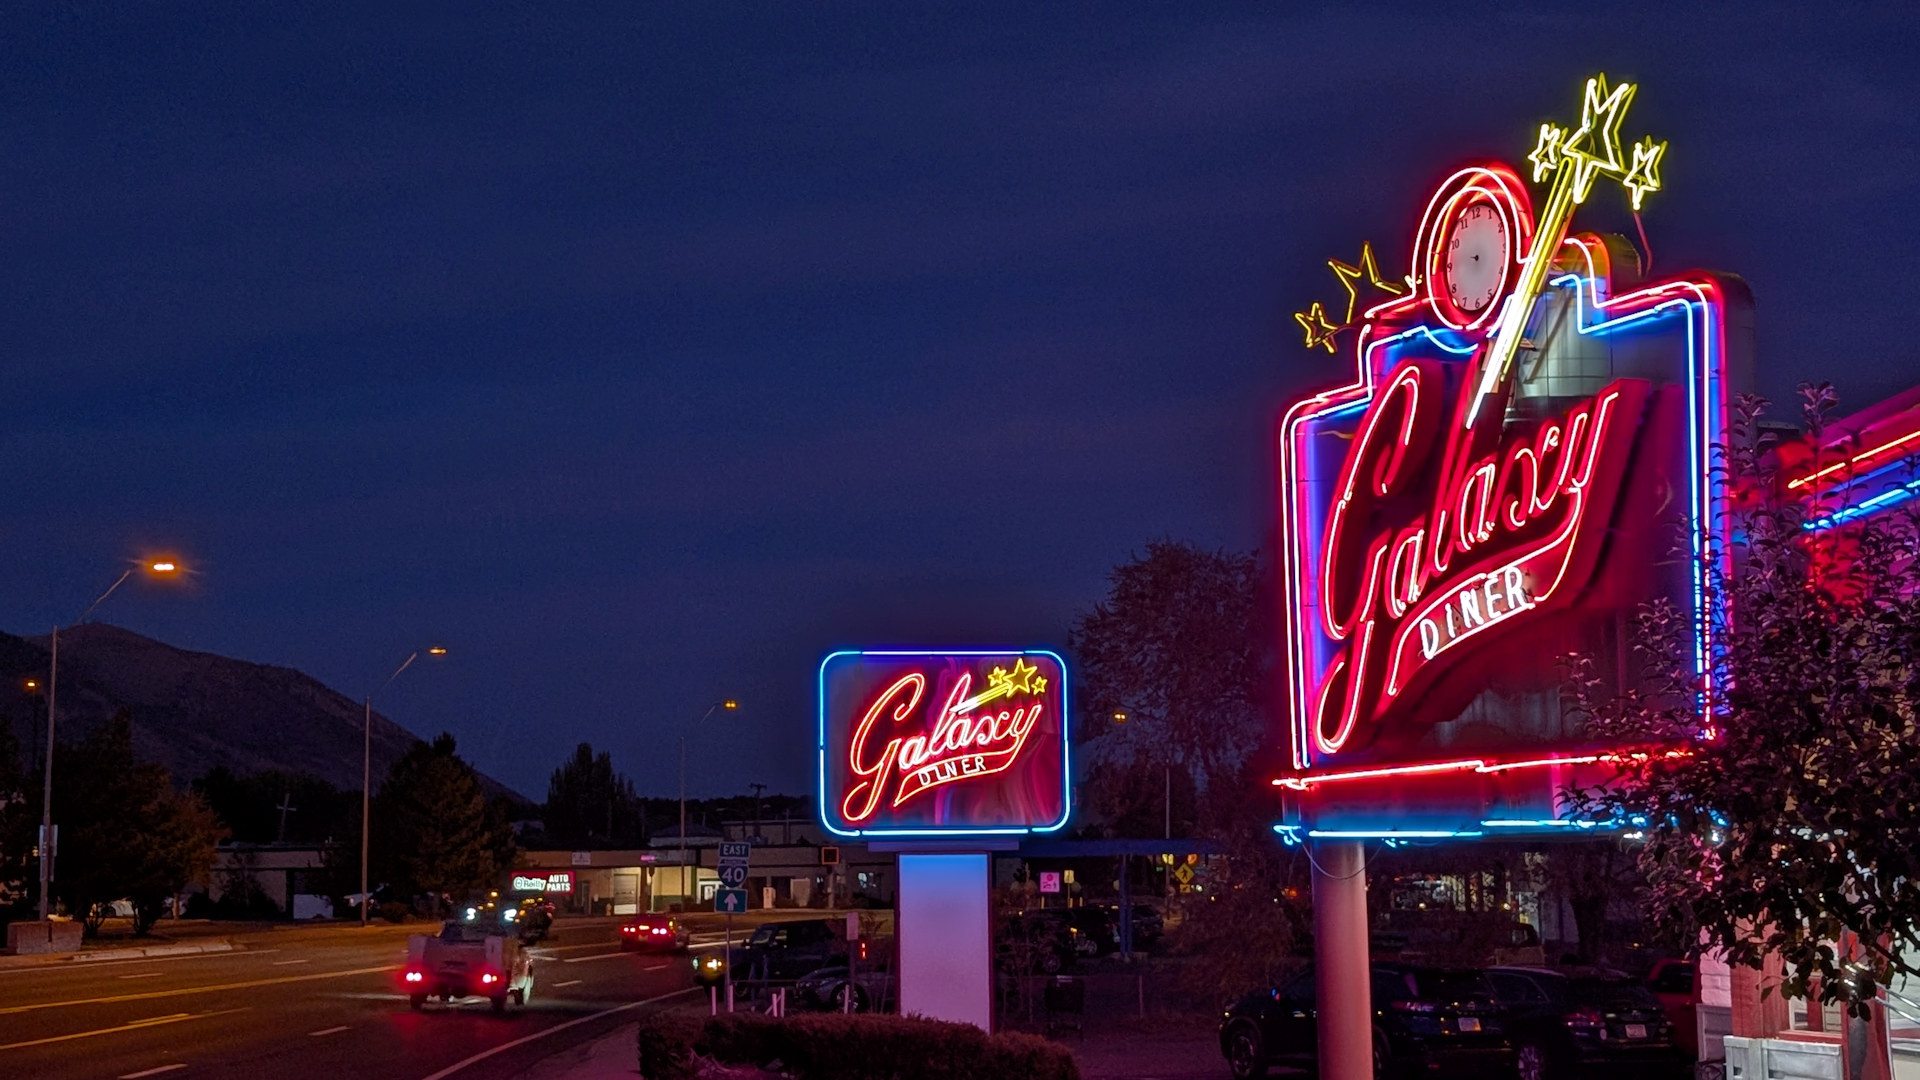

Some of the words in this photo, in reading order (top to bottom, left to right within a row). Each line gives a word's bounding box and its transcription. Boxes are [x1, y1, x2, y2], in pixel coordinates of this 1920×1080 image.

[1472, 207, 1481, 219] 12
[1488, 209, 1492, 219] 1
[1460, 219, 1468, 229] 11
[1498, 223, 1503, 233] 2
[1451, 239, 1460, 250] 10
[1446, 262, 1452, 272] 9
[1451, 283, 1457, 293] 8
[1487, 289, 1493, 300] 5
[1462, 297, 1467, 307] 7
[1474, 298, 1480, 308] 6
[1315, 352, 1624, 754] Galaxy
[1419, 566, 1535, 660] DINER
[842, 672, 1042, 821] Galaxy
[918, 756, 986, 786] DINER
[723, 844, 747, 855] EAST
[548, 874, 569, 882] AUTO
[721, 867, 744, 883] 40
[546, 882, 571, 891] PARTS
